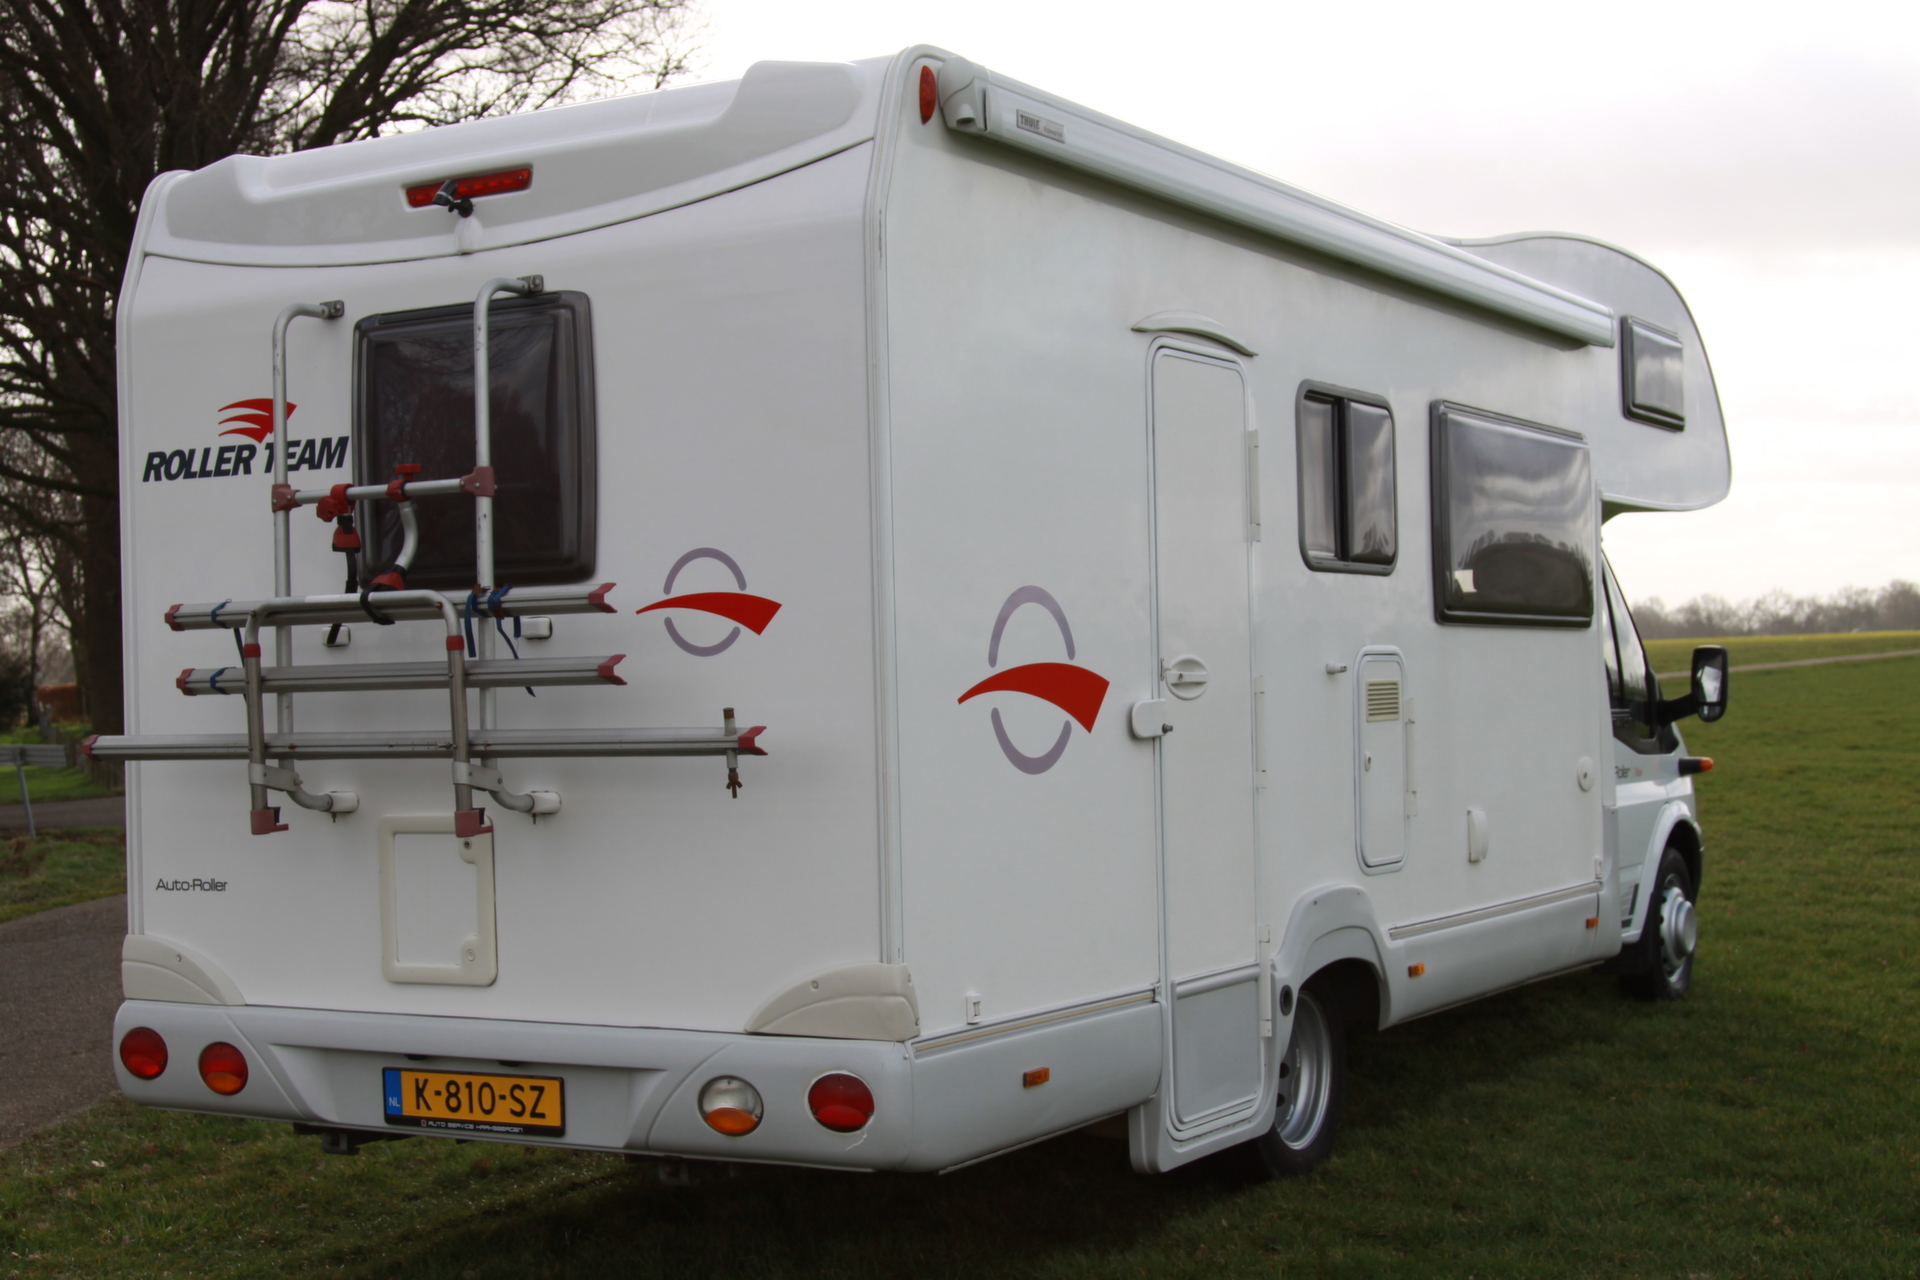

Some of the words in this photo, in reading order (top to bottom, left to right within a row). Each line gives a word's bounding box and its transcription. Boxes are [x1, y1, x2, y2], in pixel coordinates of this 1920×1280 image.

[1020, 113, 1040, 130] THULE
[142, 443, 257, 482] ROLLER
[388, 1096, 401, 1107] NL
[414, 1078, 547, 1119] K-810-SZ
[428, 1120, 446, 1128] AUTO
[447, 1122, 474, 1130] SERVICE
